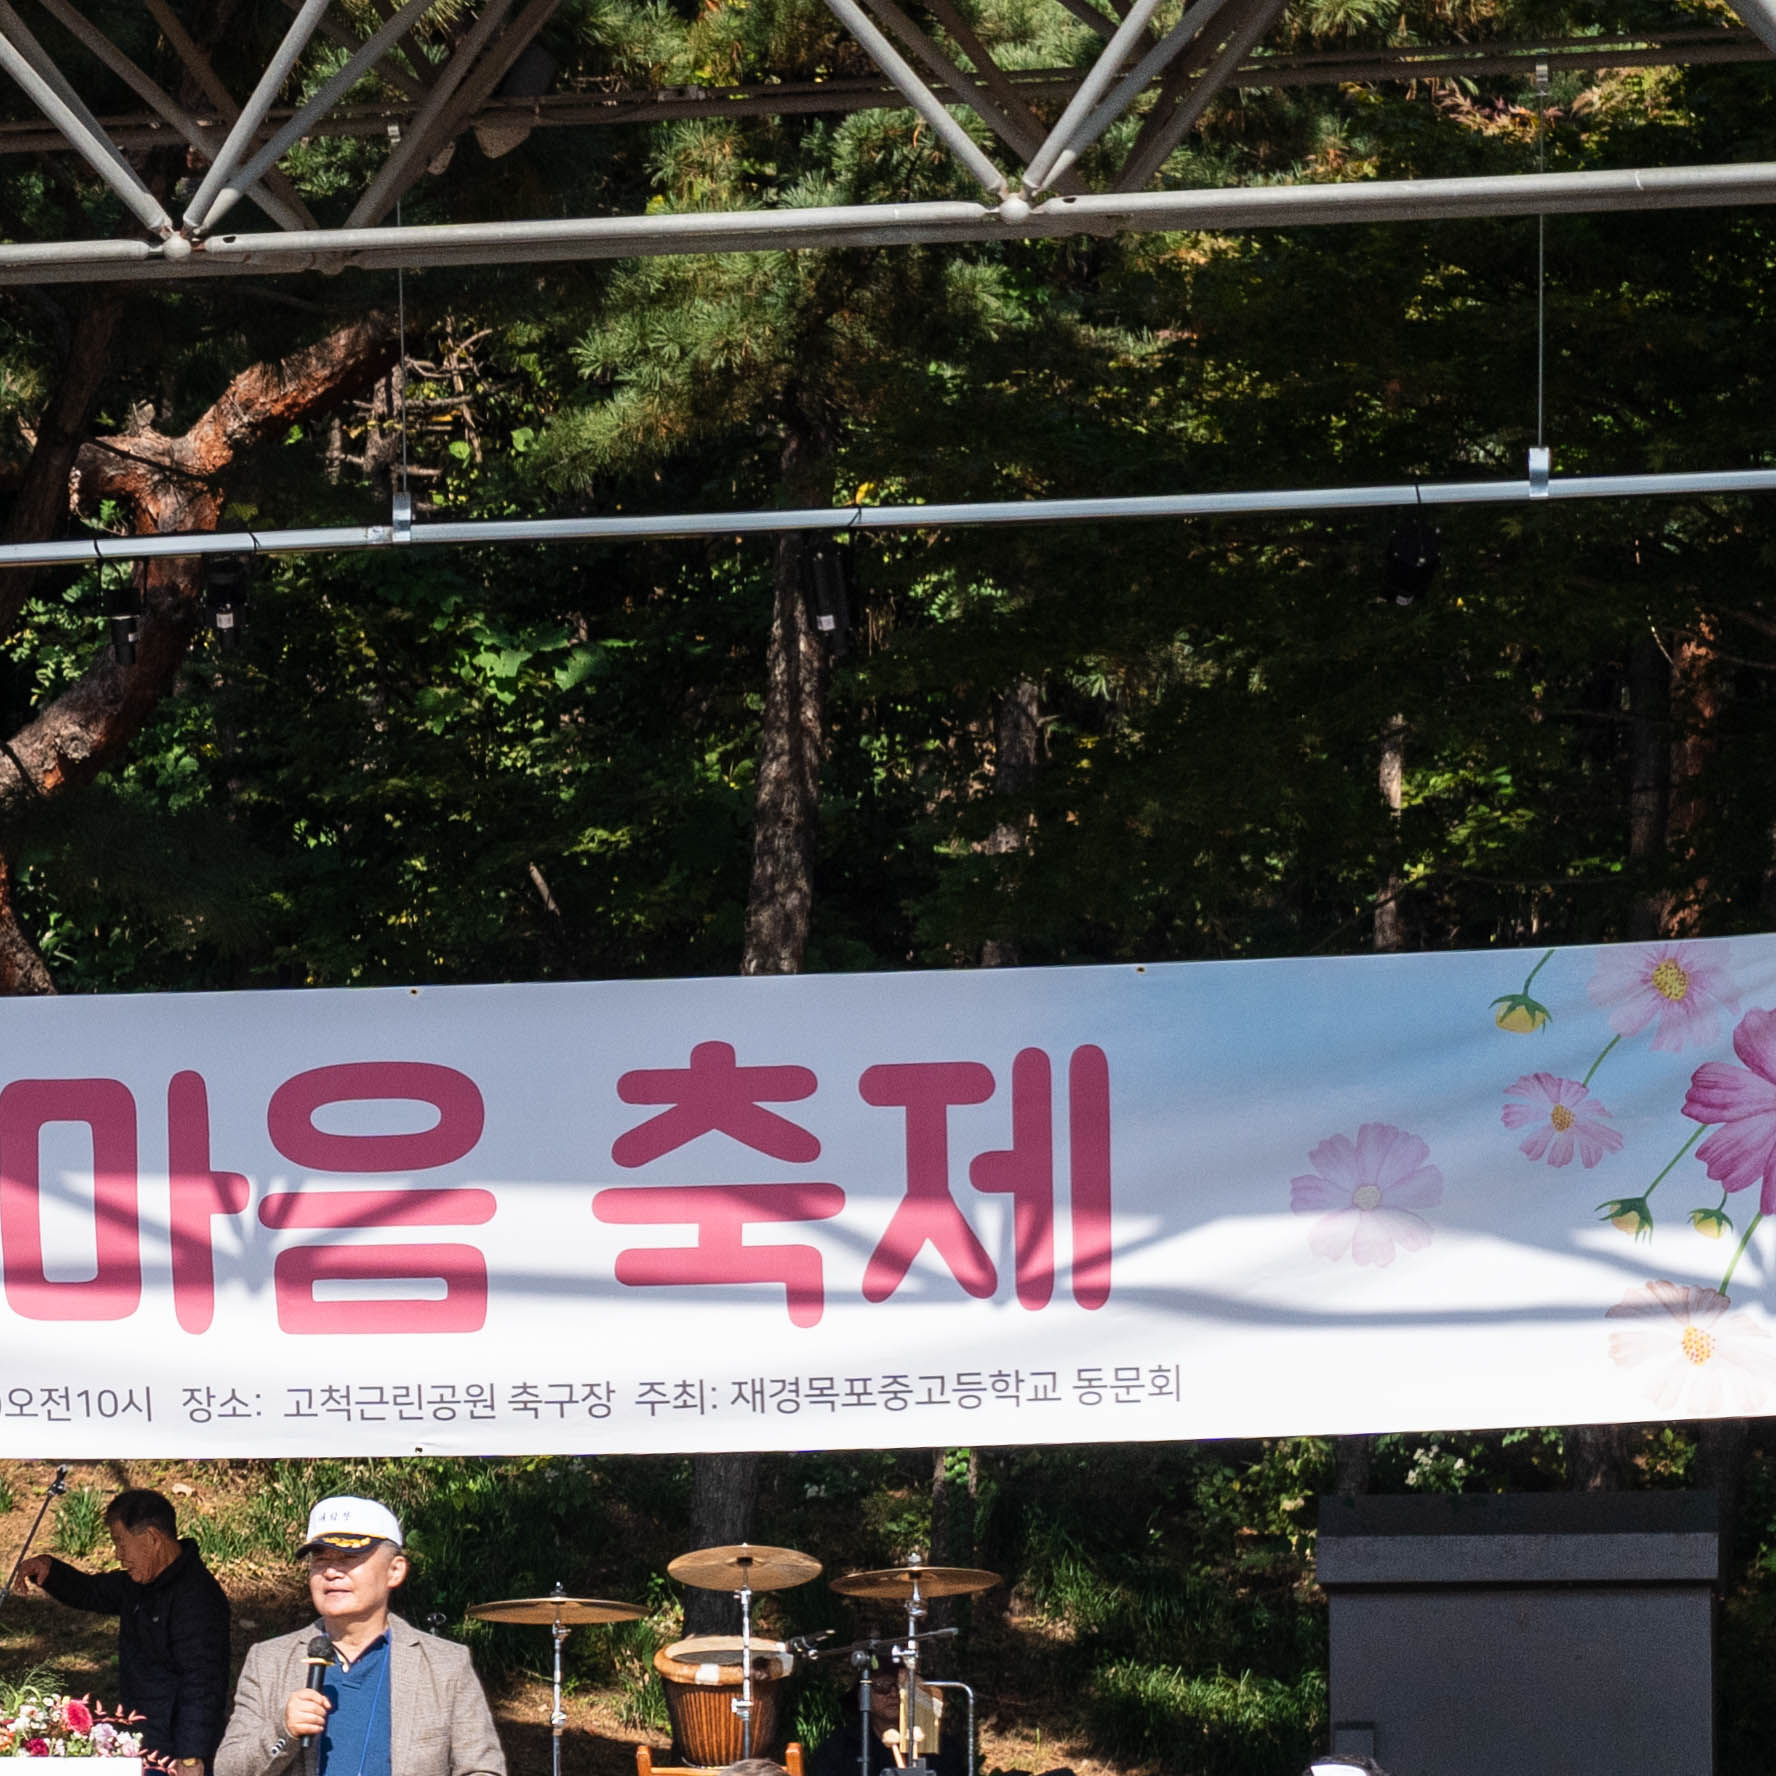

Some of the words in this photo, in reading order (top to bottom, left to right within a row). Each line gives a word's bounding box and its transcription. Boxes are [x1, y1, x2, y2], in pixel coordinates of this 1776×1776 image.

[591, 1041, 1114, 1329] 축제
[181, 1385, 262, 1424] 장소:
[283, 1382, 497, 1423] 고척근린공원
[507, 1380, 617, 1420] 축구장
[634, 1378, 718, 1418] 주최:
[729, 1368, 1062, 1415] 재경목포중고등학교
[1072, 1363, 1181, 1407] 동문회
